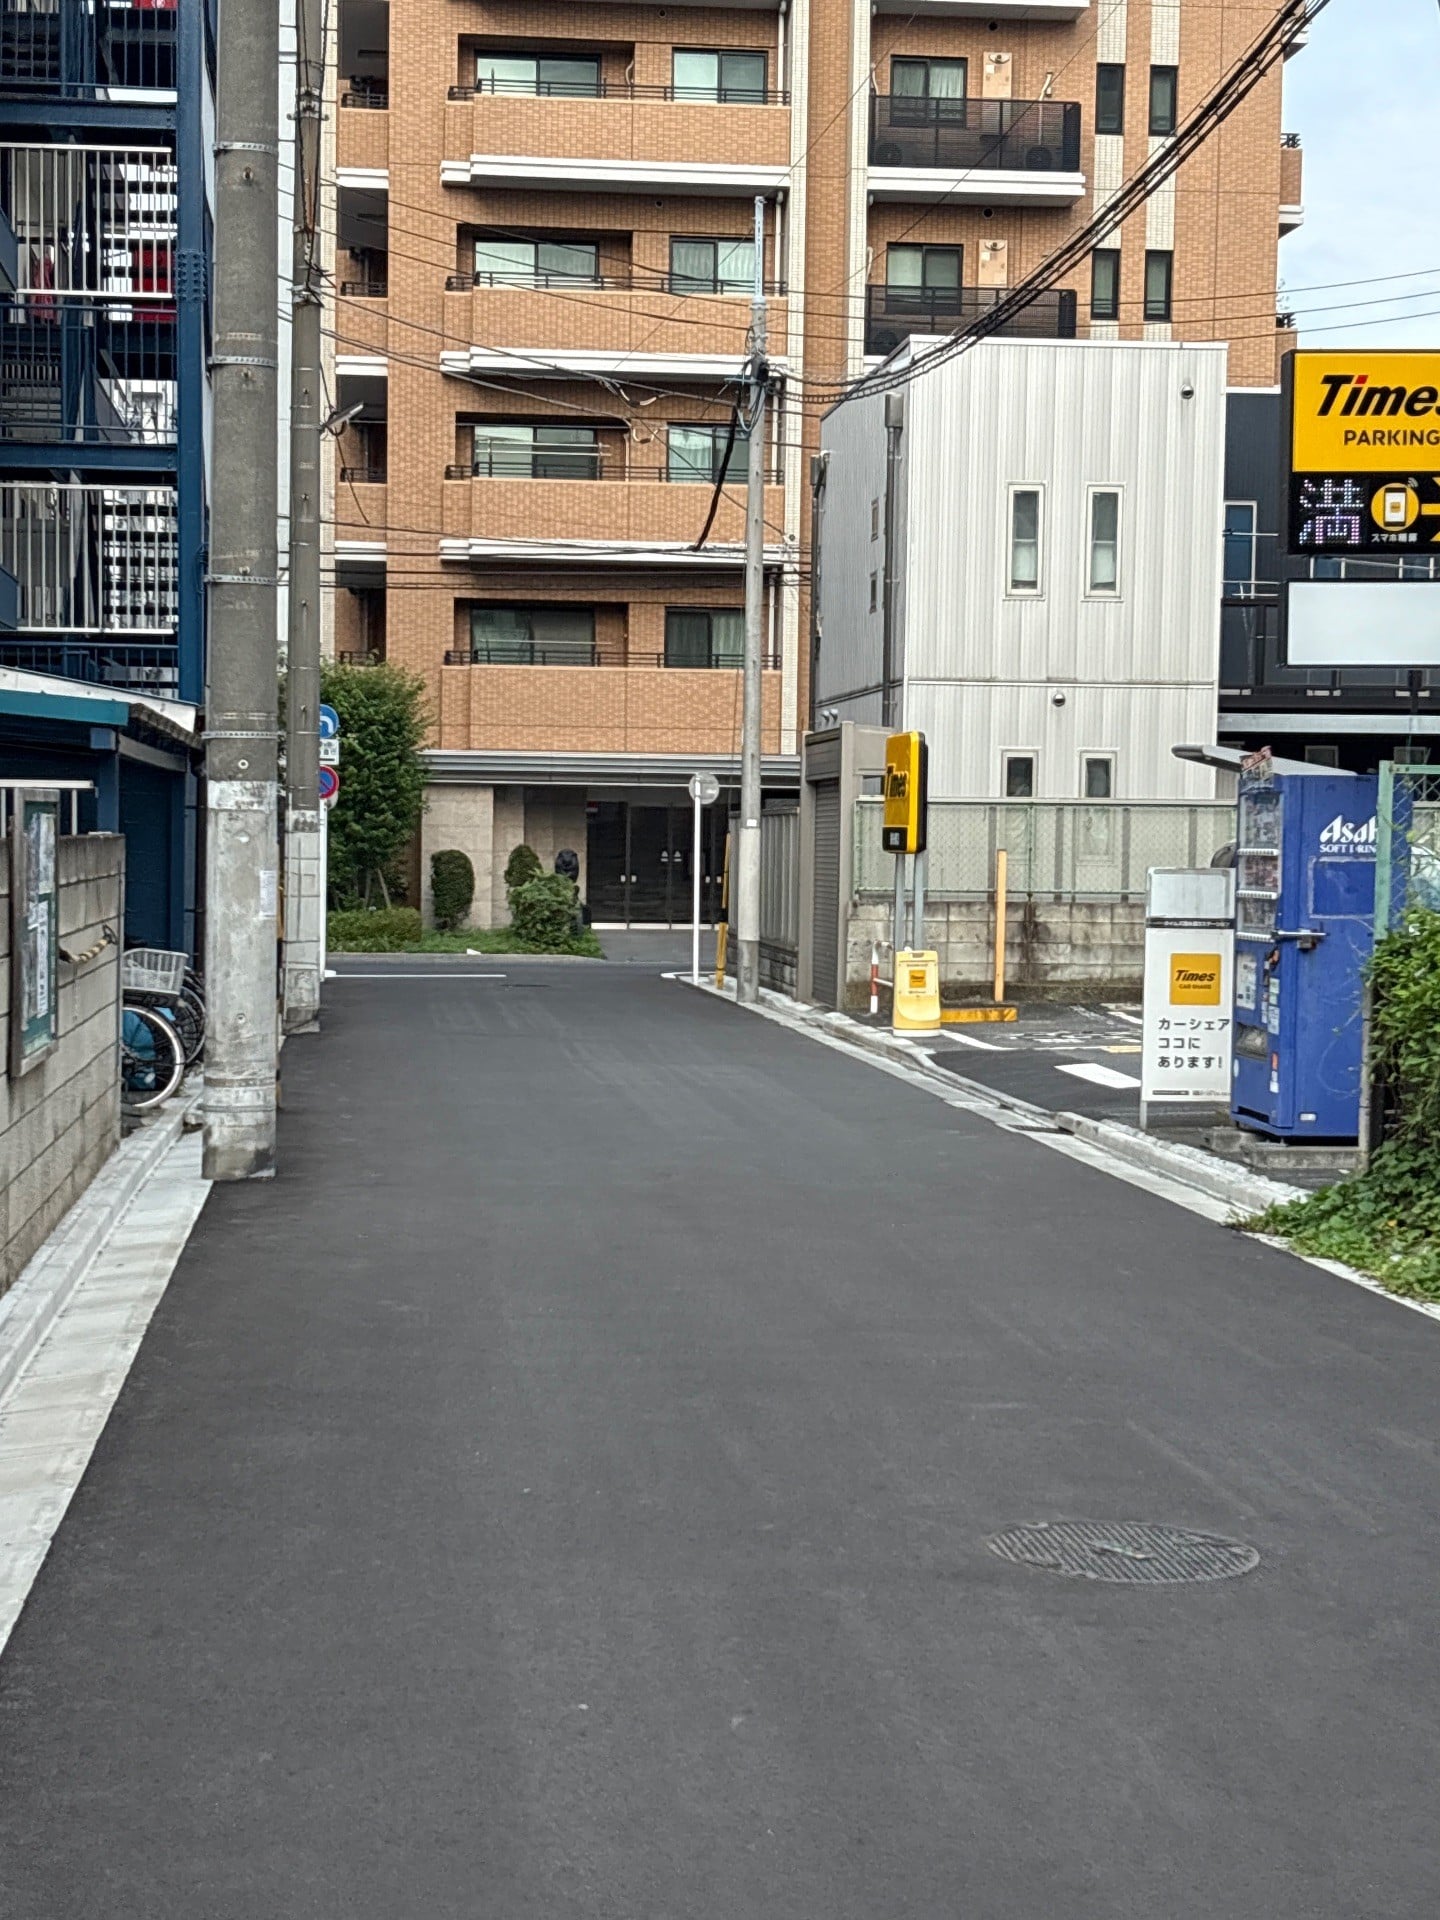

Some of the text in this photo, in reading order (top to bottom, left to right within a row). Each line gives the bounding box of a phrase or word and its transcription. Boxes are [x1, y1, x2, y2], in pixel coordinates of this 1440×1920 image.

[1317, 374, 1440, 417] Time
[1343, 429, 1440, 447] PARKING
[1299, 479, 1364, 544] 満
[1319, 814, 1378, 843] Asah
[1319, 844, 1377, 853] SOFT DRIN
[1175, 970, 1216, 982] Times
[1158, 1018, 1230, 1030] カーシェア
[1158, 1037, 1201, 1049] ココに
[1158, 1056, 1223, 1069] あります!
